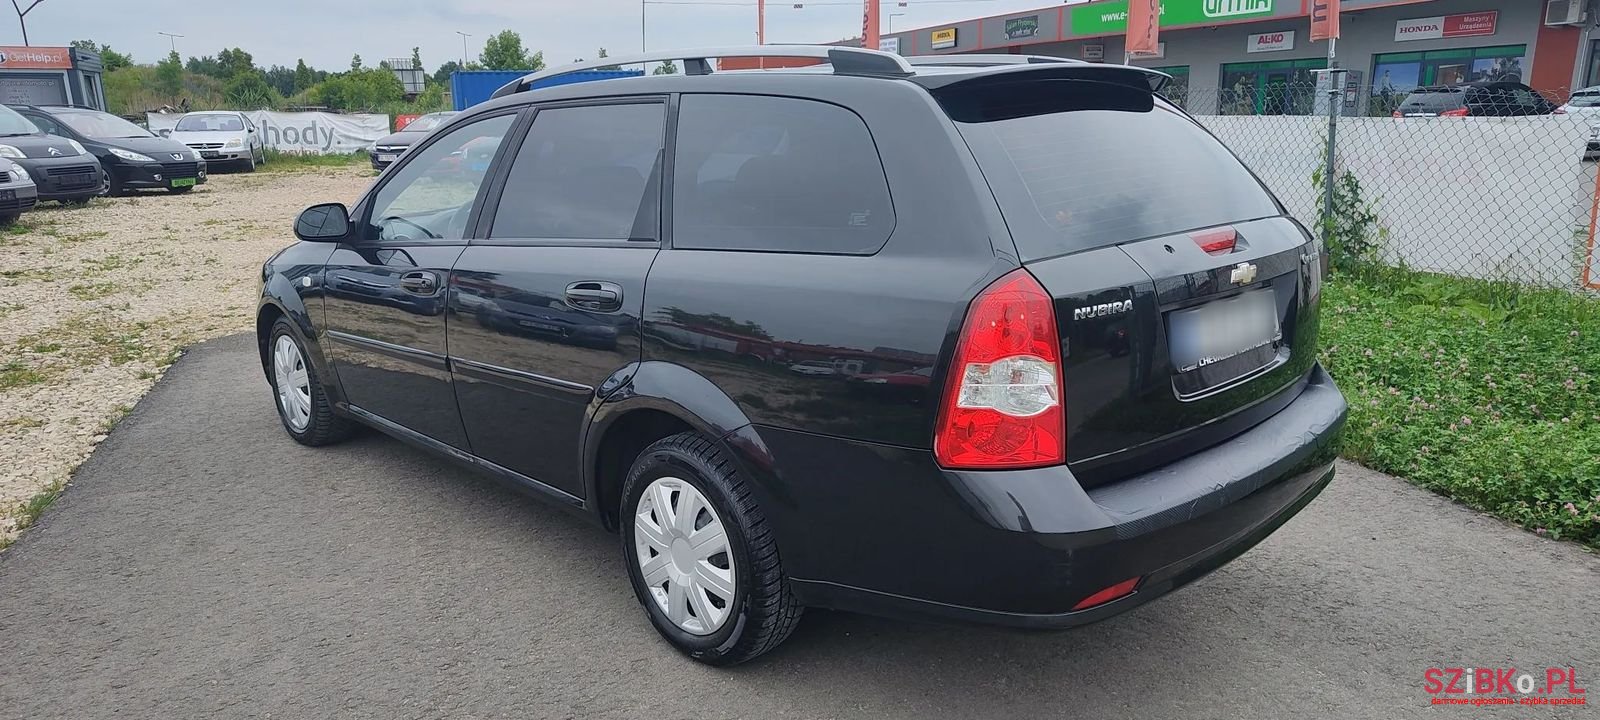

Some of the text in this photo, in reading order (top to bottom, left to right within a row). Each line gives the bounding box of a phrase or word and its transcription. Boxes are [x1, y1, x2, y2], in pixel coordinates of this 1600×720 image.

[1463, 14, 1491, 23] Maszyny
[1399, 24, 1439, 34] HONDA
[1459, 22, 1492, 30] Urządzenia
[8, 52, 63, 63] GetHelp.pl
[1074, 299, 1133, 321] NUBIRA
